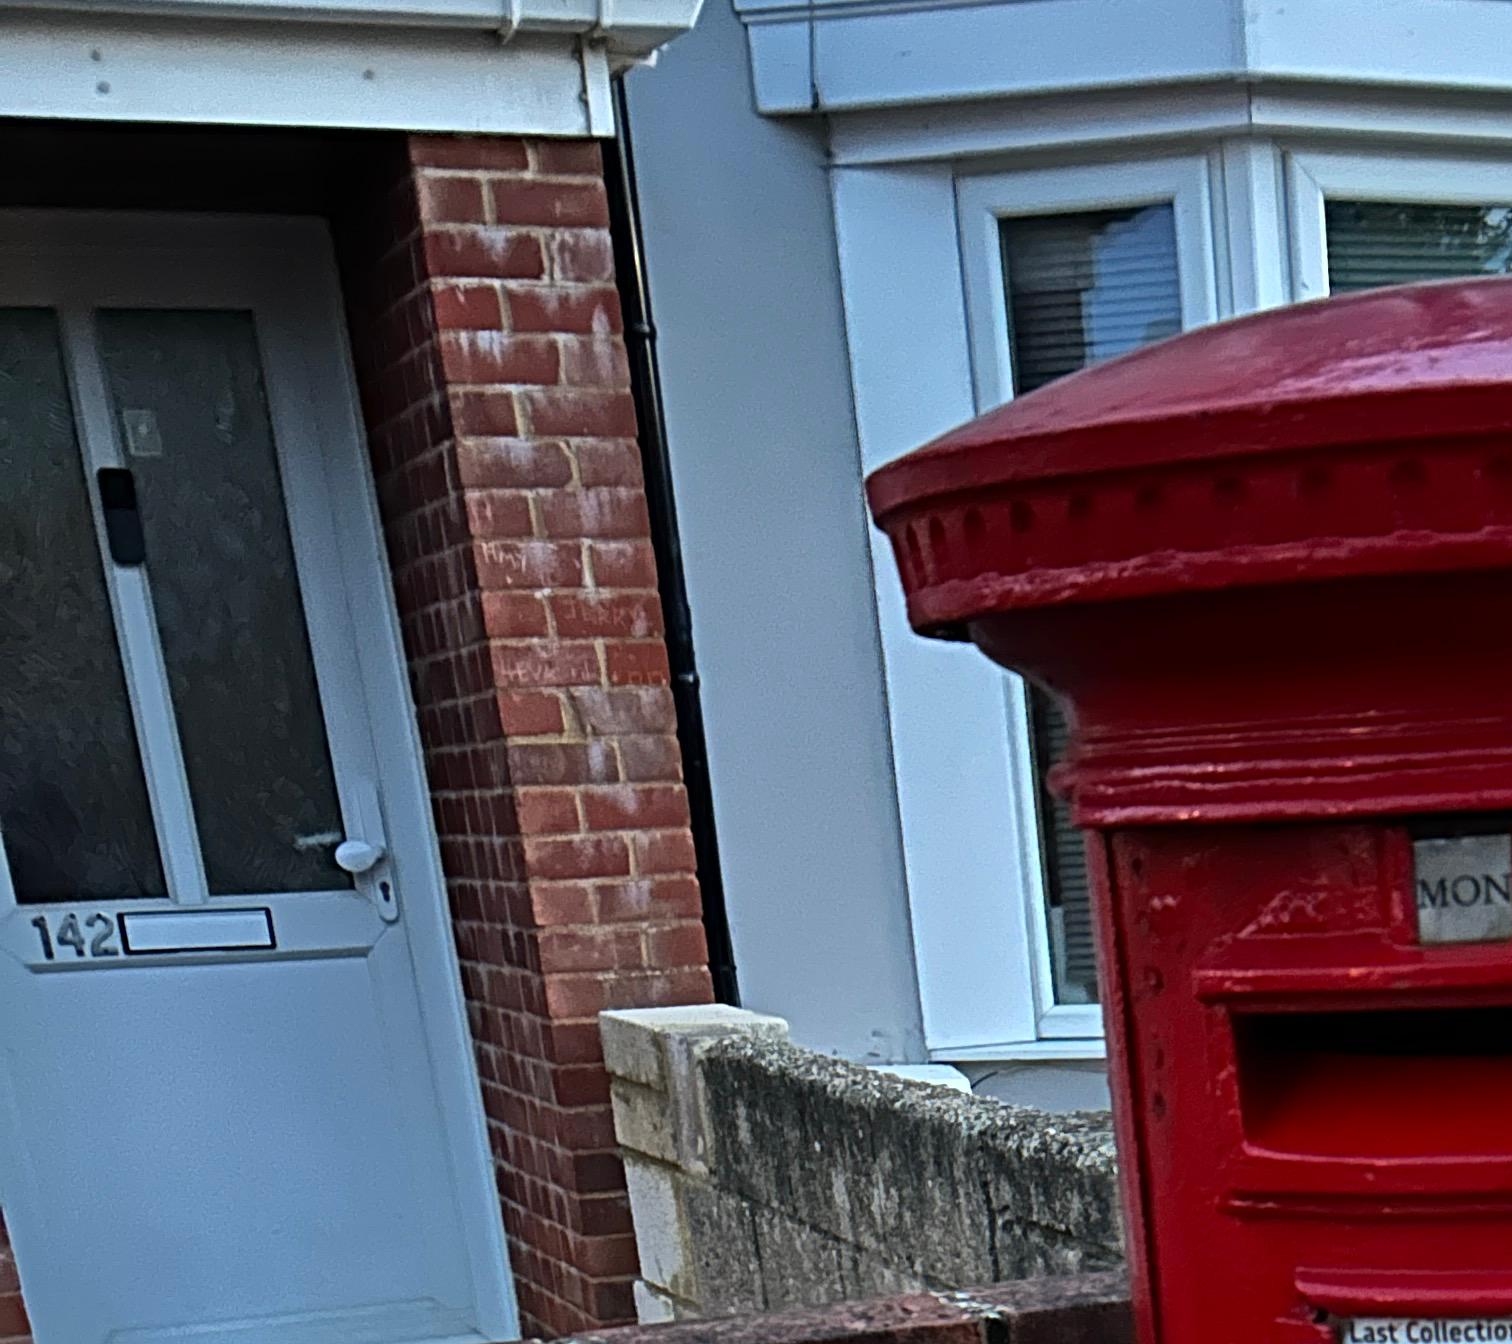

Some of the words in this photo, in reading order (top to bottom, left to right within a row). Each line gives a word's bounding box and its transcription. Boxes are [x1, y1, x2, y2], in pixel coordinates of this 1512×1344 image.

[1417, 873, 1512, 910] MON
[31, 911, 119, 960] 142
[1350, 1320, 1399, 1344] Last
